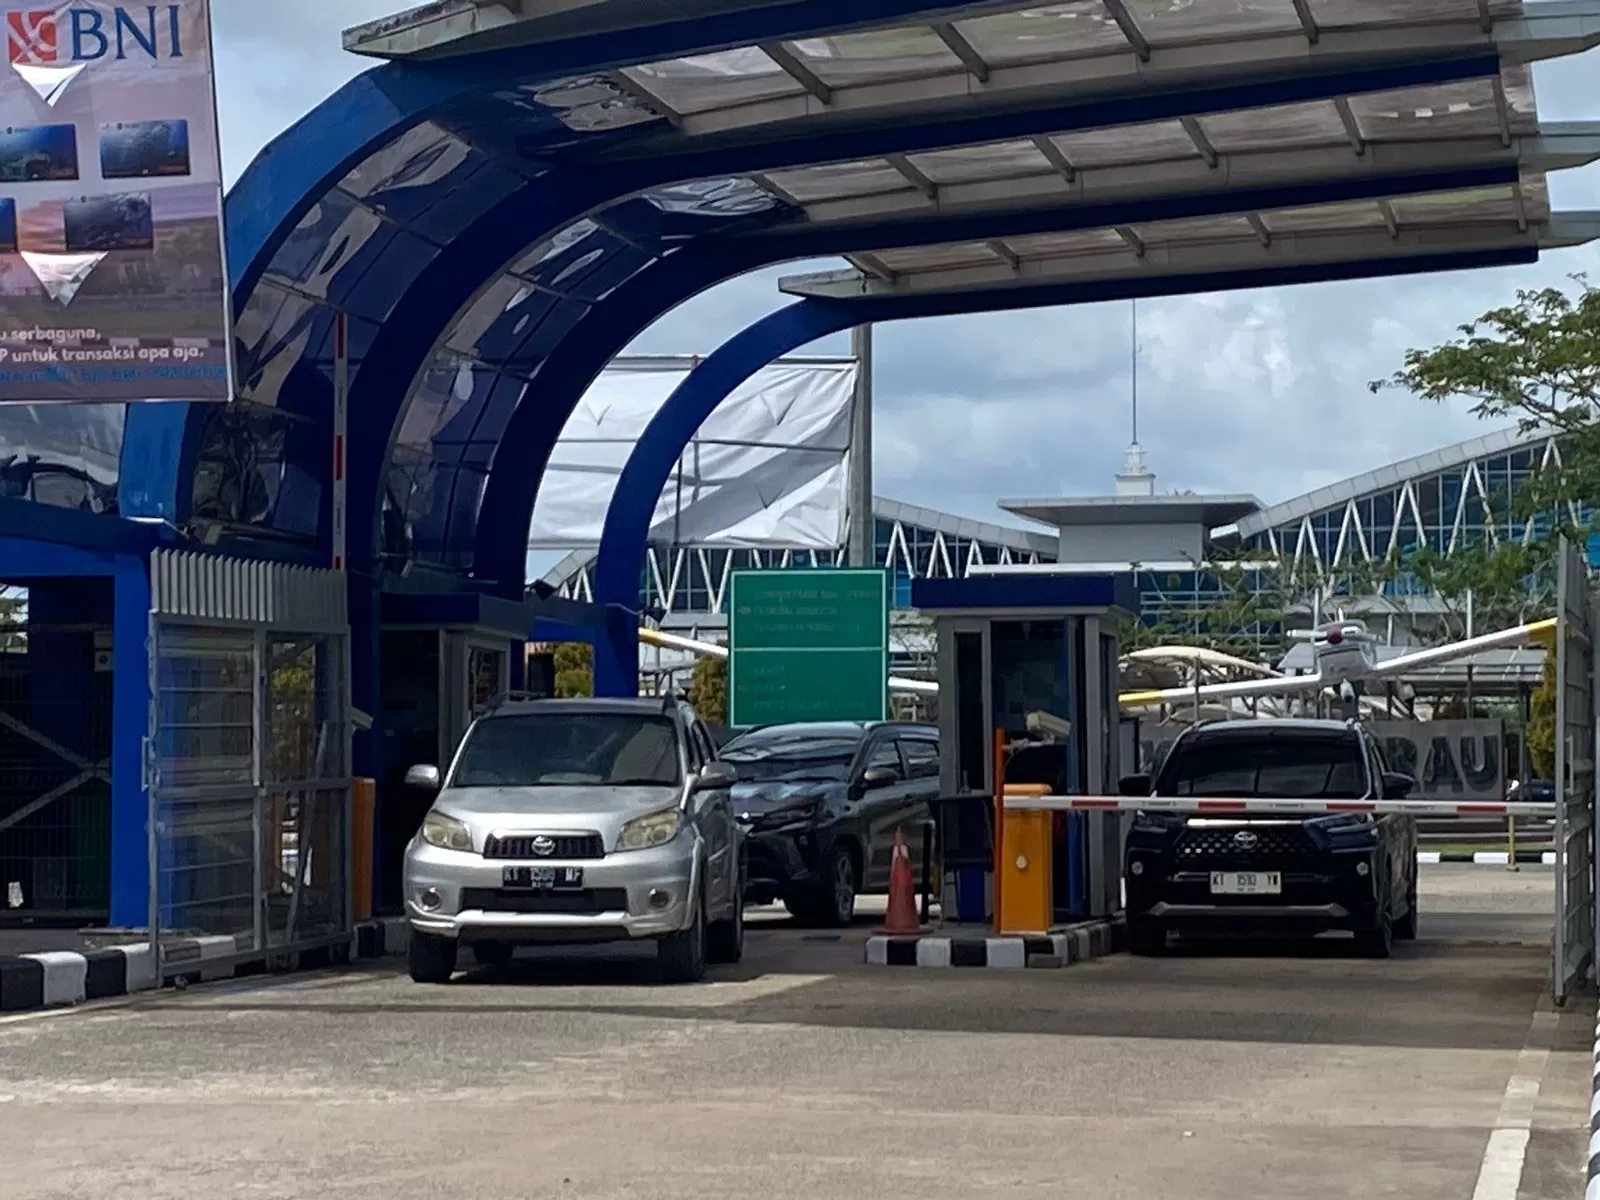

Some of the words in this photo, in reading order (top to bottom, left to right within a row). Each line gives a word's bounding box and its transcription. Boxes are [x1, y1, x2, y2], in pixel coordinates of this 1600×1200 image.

[69, 4, 183, 61] BNI
[11, 325, 101, 344] serbaguna,
[12, 346, 58, 362] untuk
[62, 345, 134, 361] transaksi
[138, 346, 169, 362] apa
[173, 345, 204, 362] aja.
